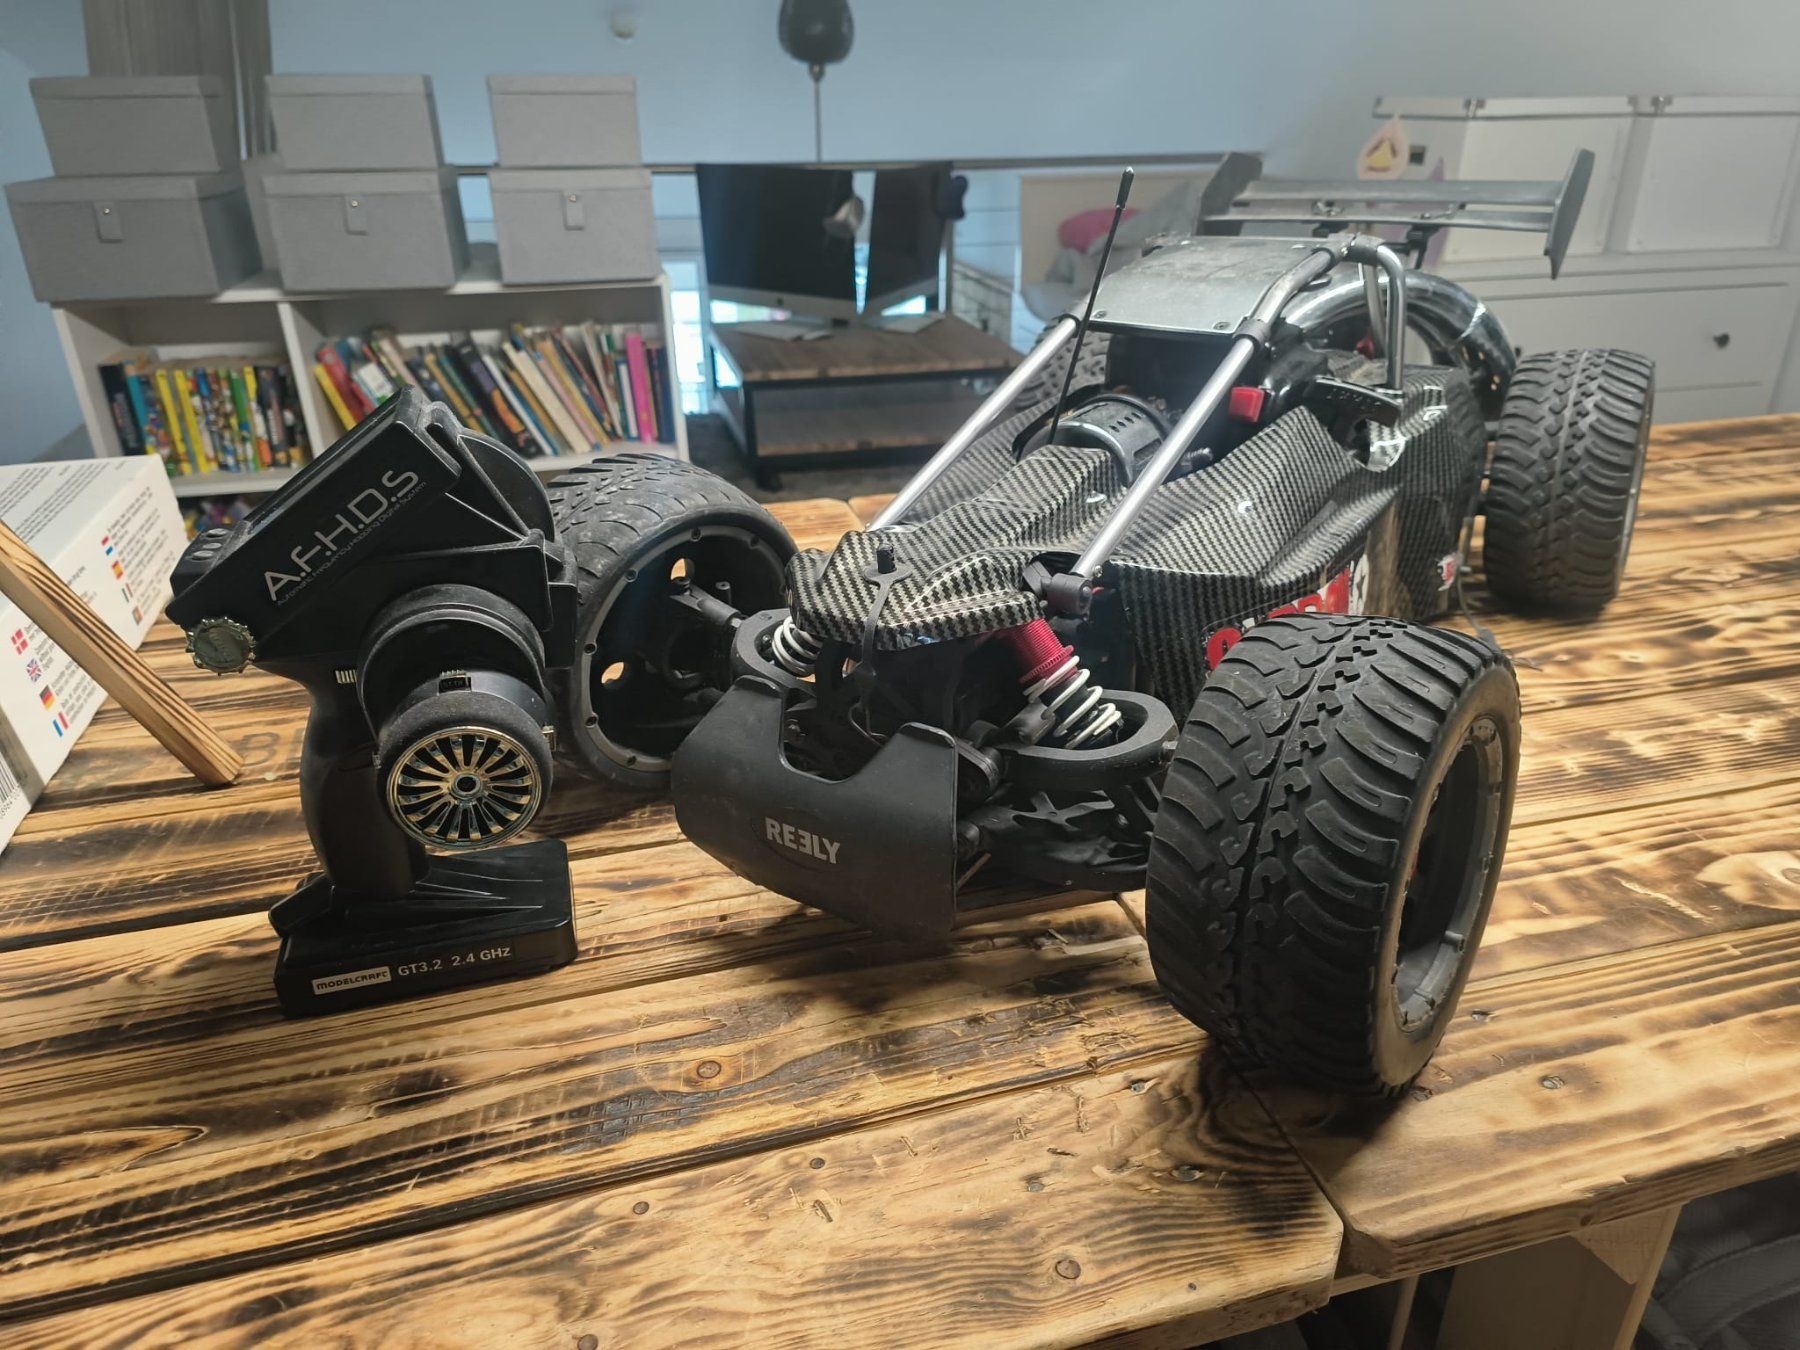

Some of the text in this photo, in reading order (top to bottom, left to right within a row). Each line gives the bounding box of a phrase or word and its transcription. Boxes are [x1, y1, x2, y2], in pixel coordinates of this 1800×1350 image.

[765, 816, 840, 864] REELY
[398, 946, 511, 976] GT3.2 2.4 GHz
[316, 970, 389, 991] MODELCRAFT
